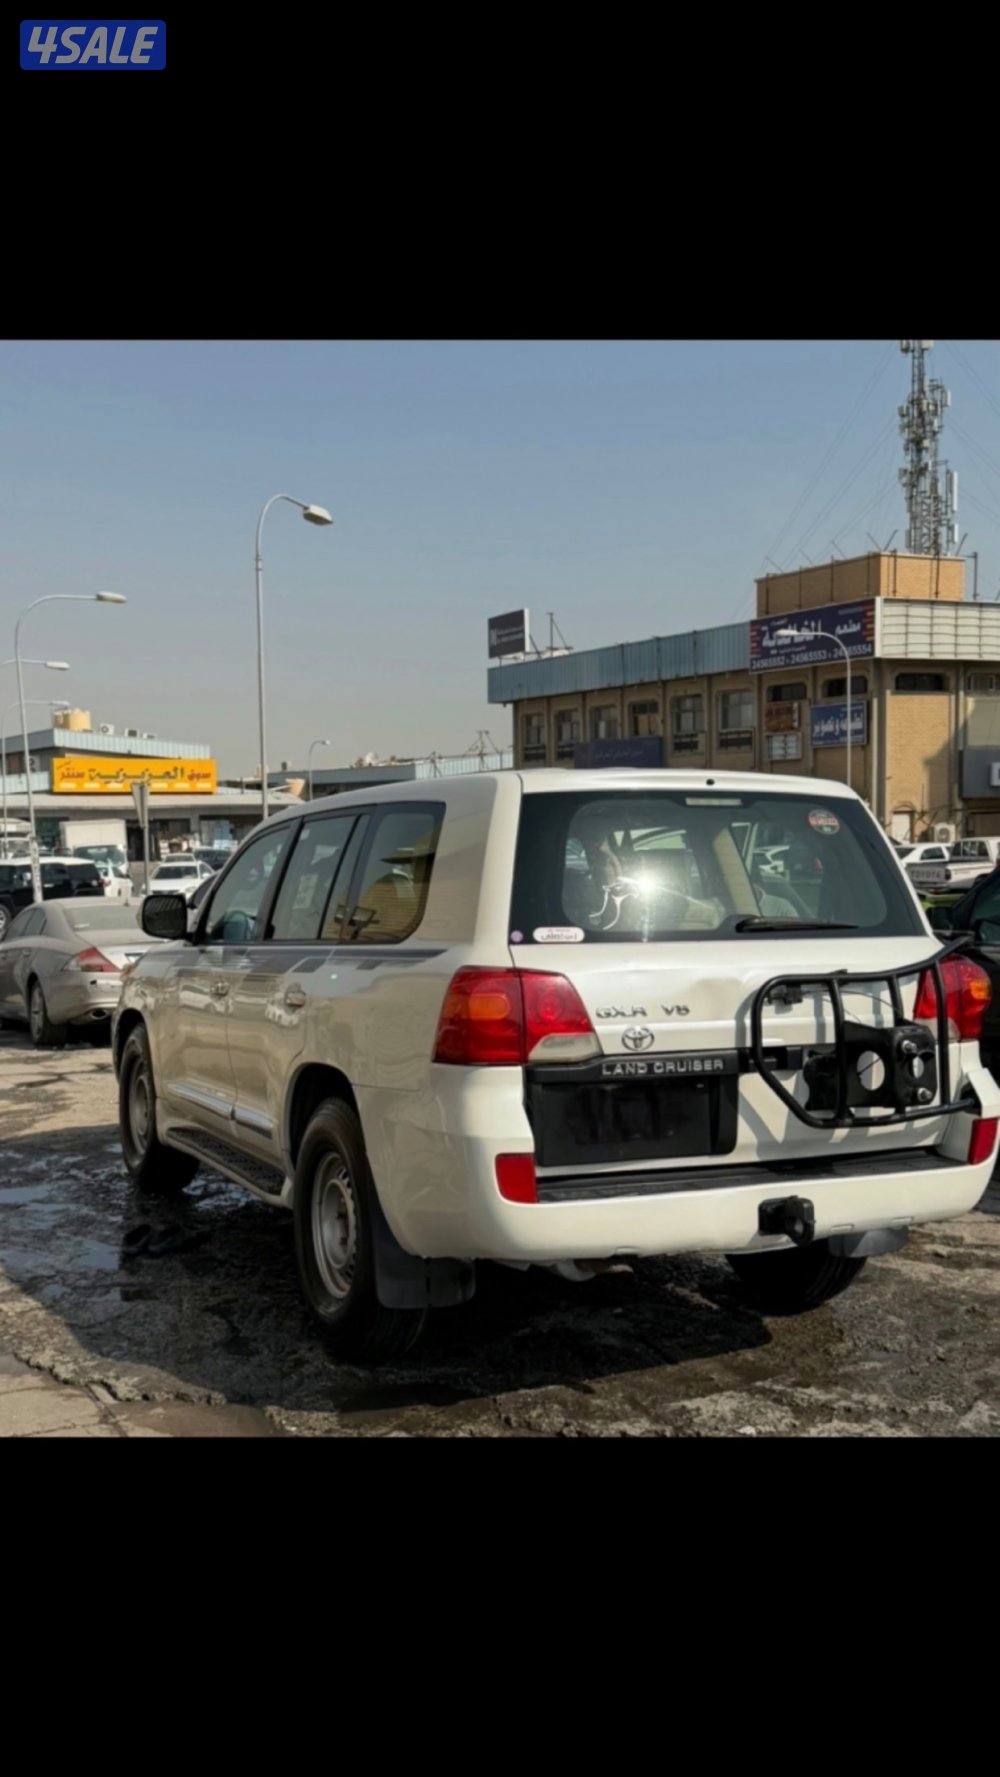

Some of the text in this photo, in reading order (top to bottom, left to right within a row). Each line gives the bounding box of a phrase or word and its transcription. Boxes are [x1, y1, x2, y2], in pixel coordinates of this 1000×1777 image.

[187, 770, 211, 781] سوق
[911, 870, 941, 881] TOYOTA
[595, 1004, 691, 1019] GXR V8
[602, 1058, 724, 1076] LAND CRUISER
